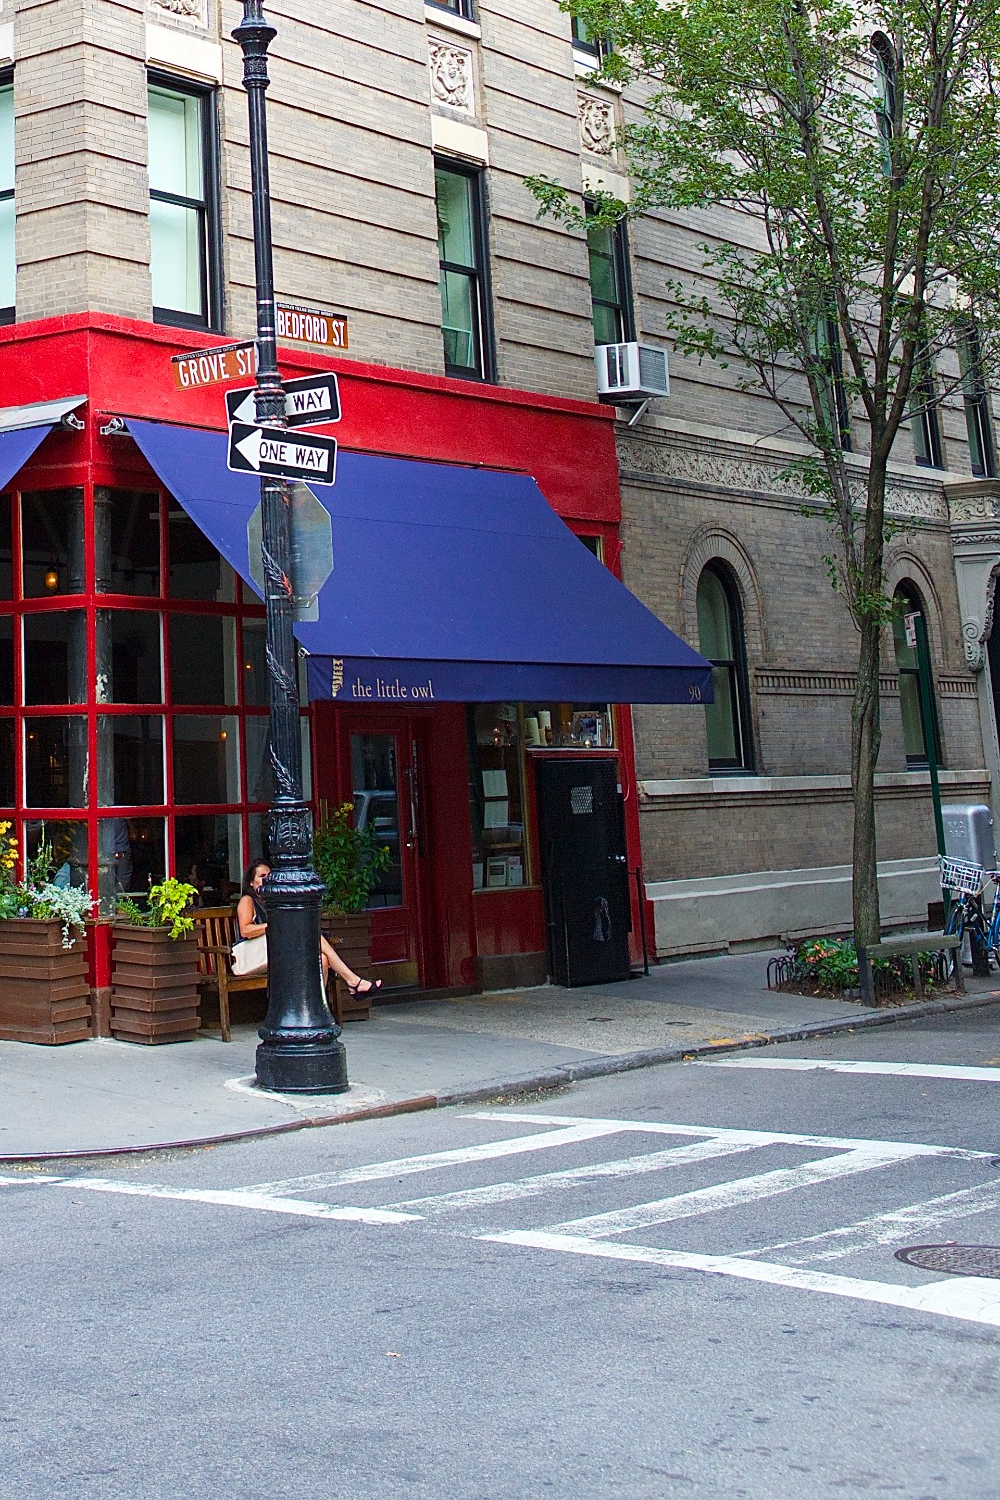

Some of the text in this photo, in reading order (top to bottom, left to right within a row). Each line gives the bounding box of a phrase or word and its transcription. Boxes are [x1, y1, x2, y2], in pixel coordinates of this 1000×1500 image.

[277, 310, 328, 344] BEDFORD
[332, 319, 345, 347] ST
[178, 353, 230, 387] GROVE
[236, 348, 252, 375] ST
[292, 389, 324, 412] WAY
[259, 441, 325, 468] ONE WAY
[351, 677, 435, 699] the little owl
[688, 685, 701, 701] 90
